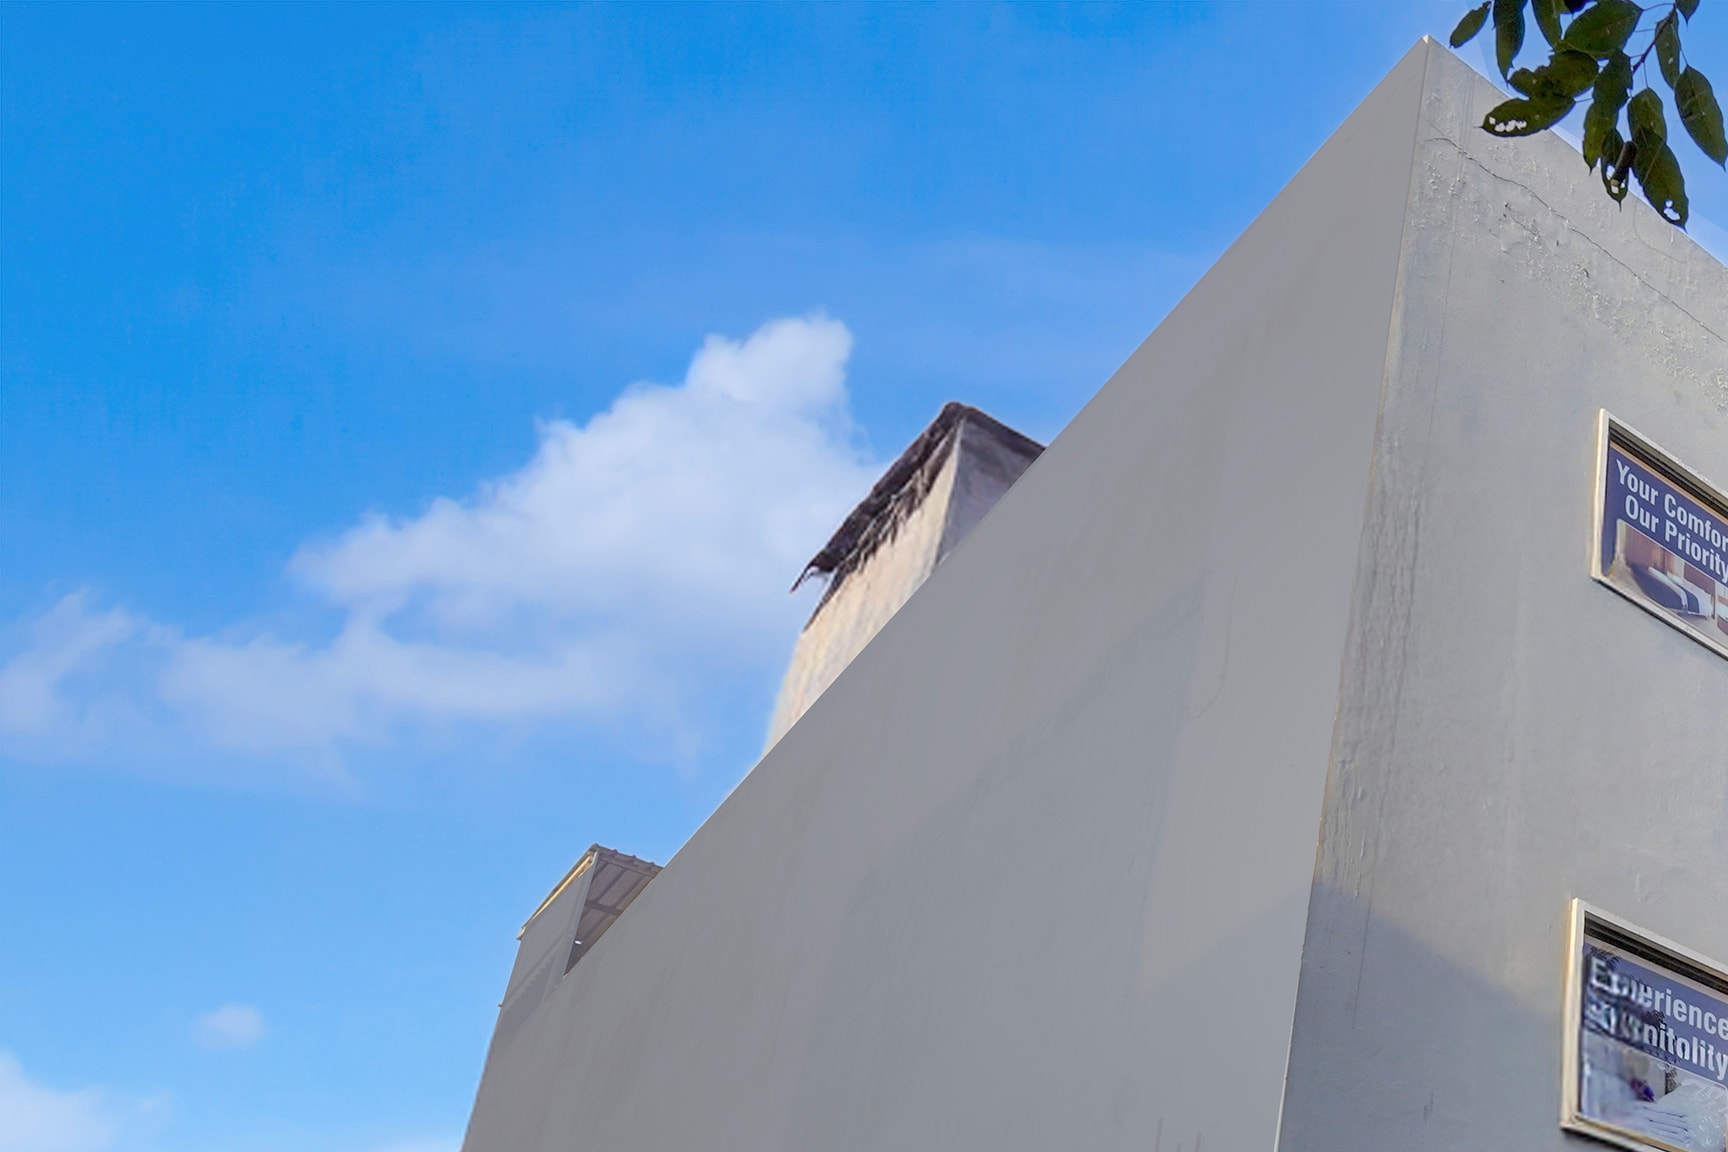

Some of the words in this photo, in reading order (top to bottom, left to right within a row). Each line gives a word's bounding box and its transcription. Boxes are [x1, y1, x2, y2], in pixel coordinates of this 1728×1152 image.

[1615, 459, 1658, 506] Your
[1625, 495, 1659, 533] Our
[1585, 999, 1728, 1081] itality
